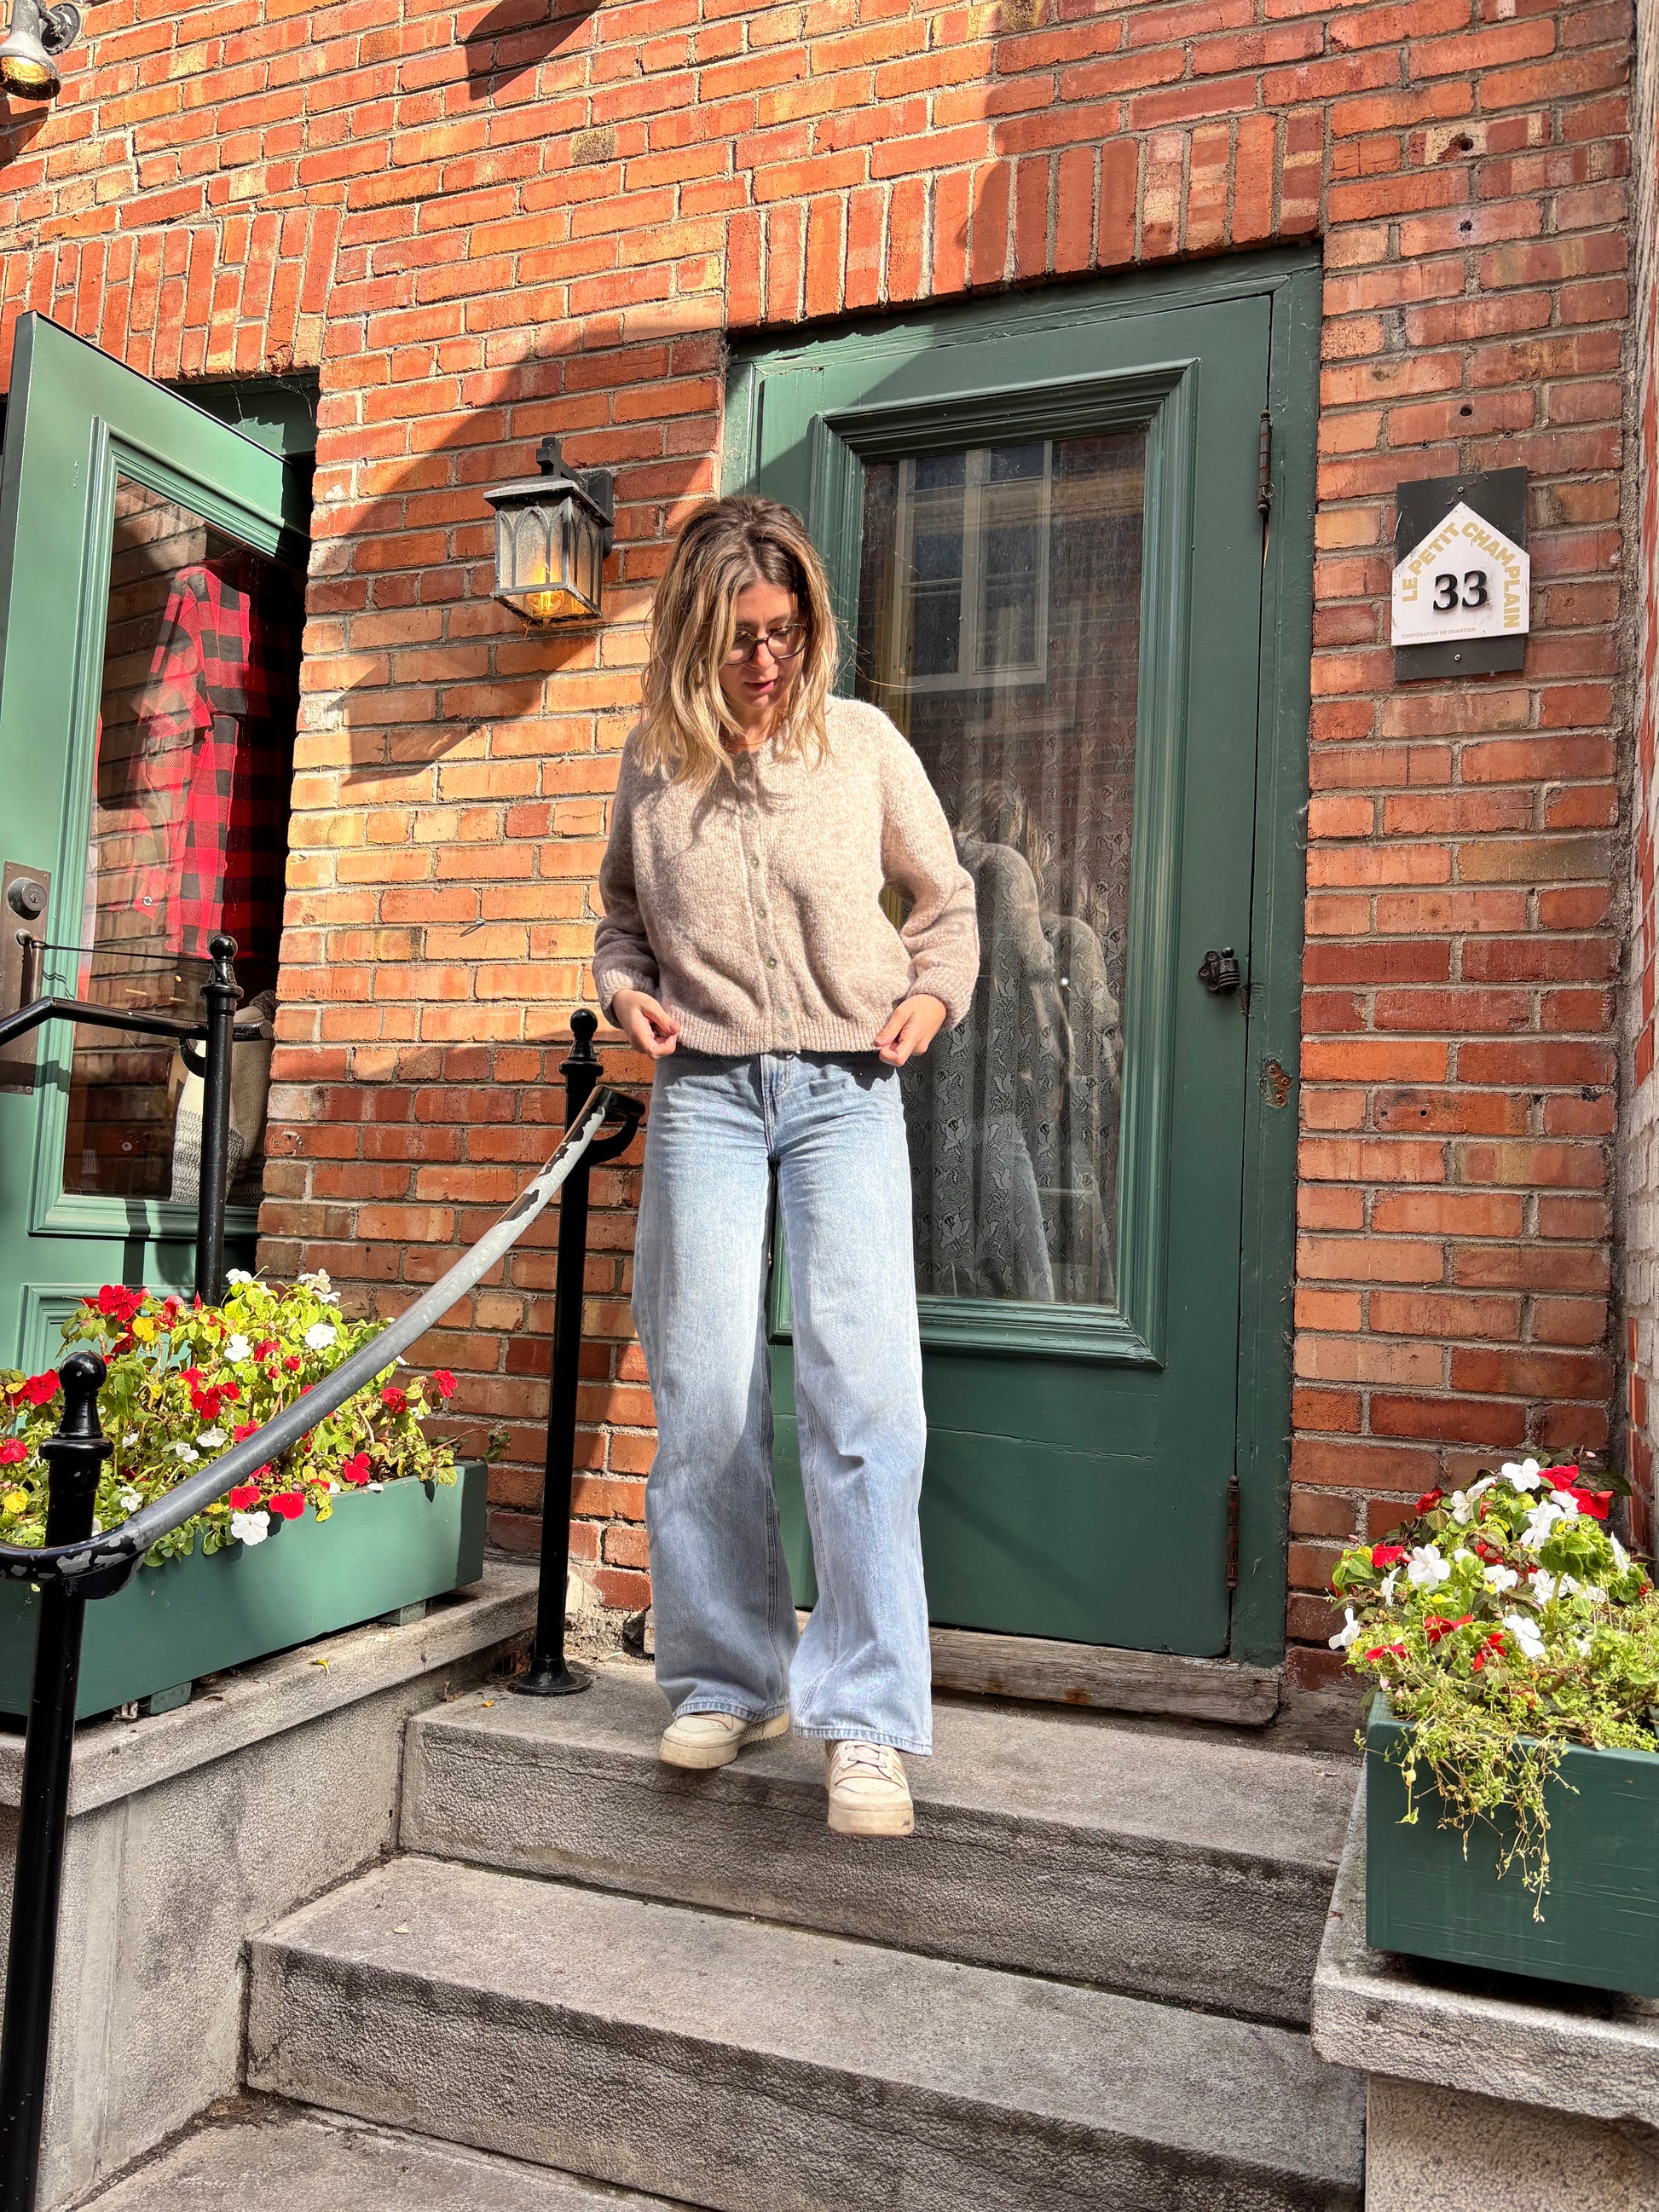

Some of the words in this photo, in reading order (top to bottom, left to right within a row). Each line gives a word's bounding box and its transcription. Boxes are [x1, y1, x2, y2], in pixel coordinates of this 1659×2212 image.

[1408, 522, 1460, 575] PETIT
[1402, 577, 1418, 602] LE
[1433, 570, 1488, 611] 33
[1462, 522, 1520, 628] CHAMPLAIN
